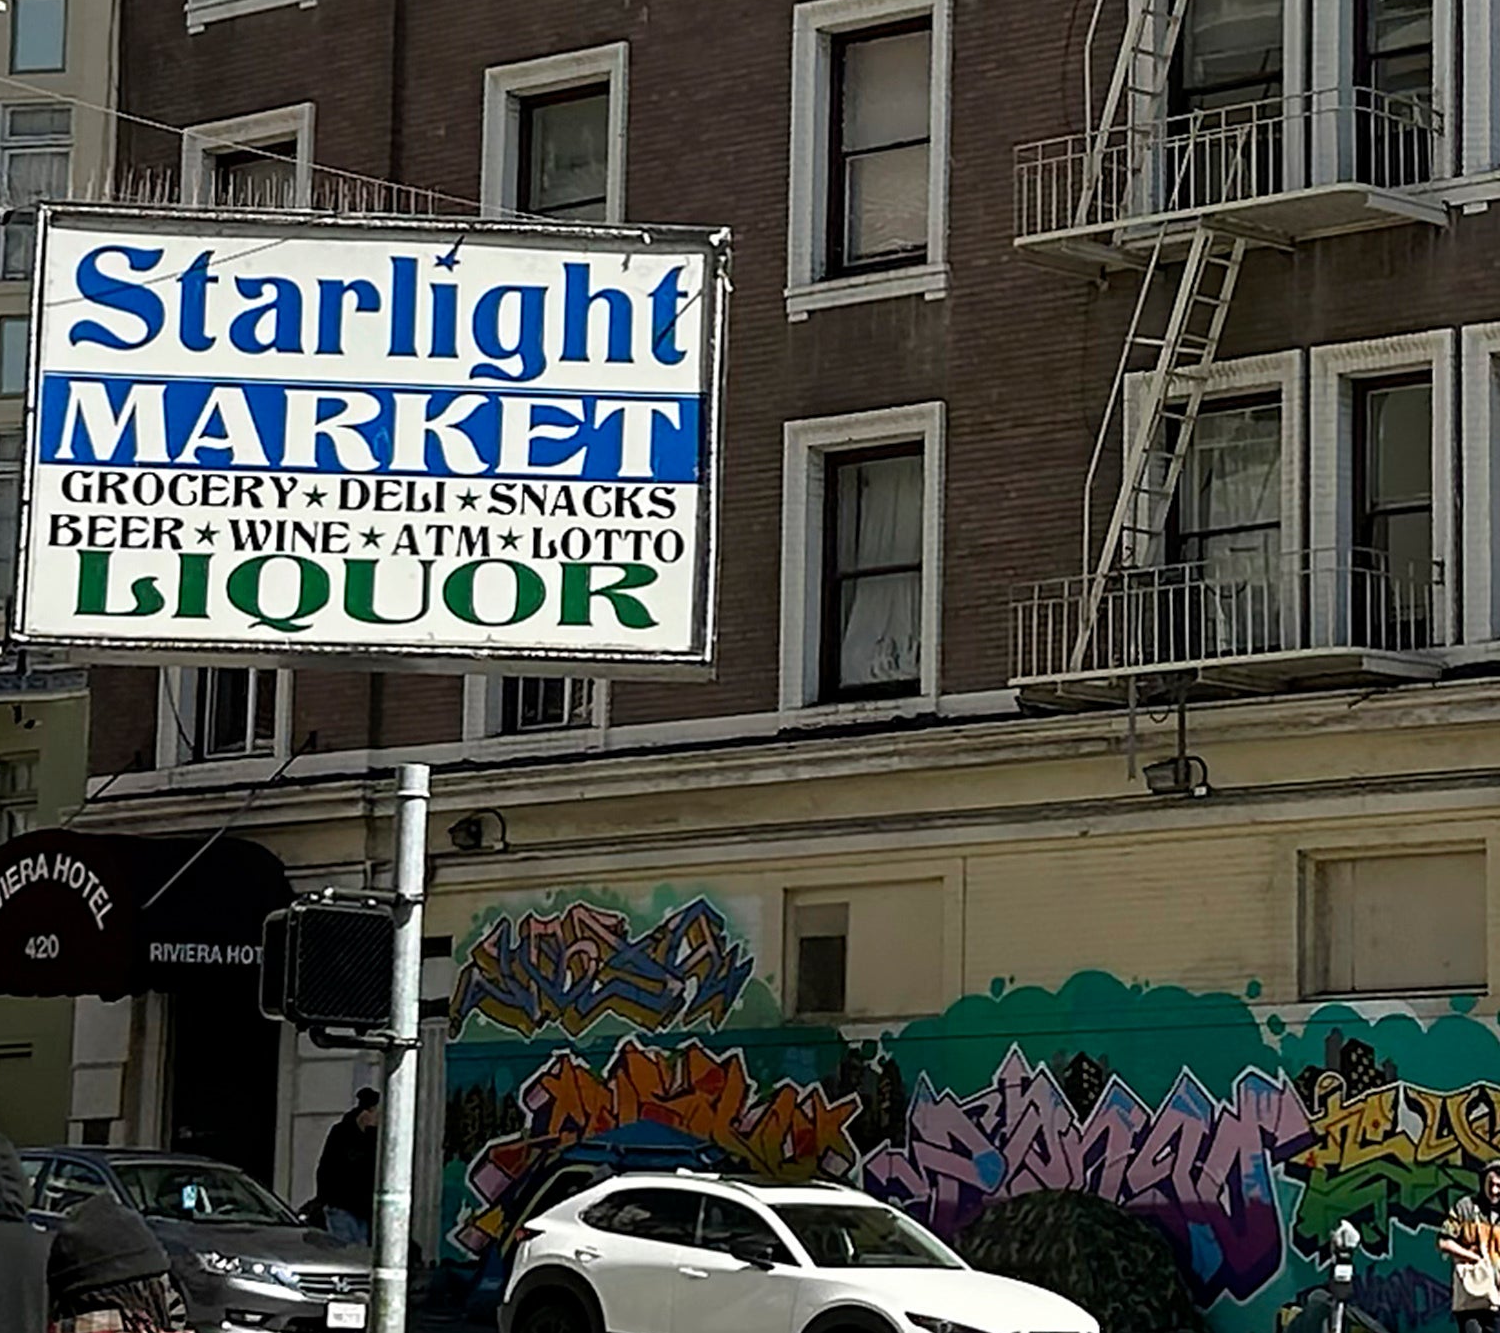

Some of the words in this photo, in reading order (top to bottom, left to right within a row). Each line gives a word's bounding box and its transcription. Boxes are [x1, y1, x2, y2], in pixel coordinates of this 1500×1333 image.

[69, 236, 689, 382] Starlight
[55, 381, 682, 479] MARKET
[61, 469, 299, 510] GROCERY
[338, 478, 446, 514] DELI
[486, 482, 676, 519] SNACKS
[47, 513, 183, 551] BEER
[229, 519, 351, 554] WINE
[393, 525, 492, 559] ATM
[531, 527, 684, 564] LOTTO
[74, 548, 660, 632] LIQUOR
[53, 853, 113, 931] HOTEL
[25, 934, 59, 959] 420
[150, 942, 223, 964] RIVIERA
[226, 944, 264, 965] HOT
